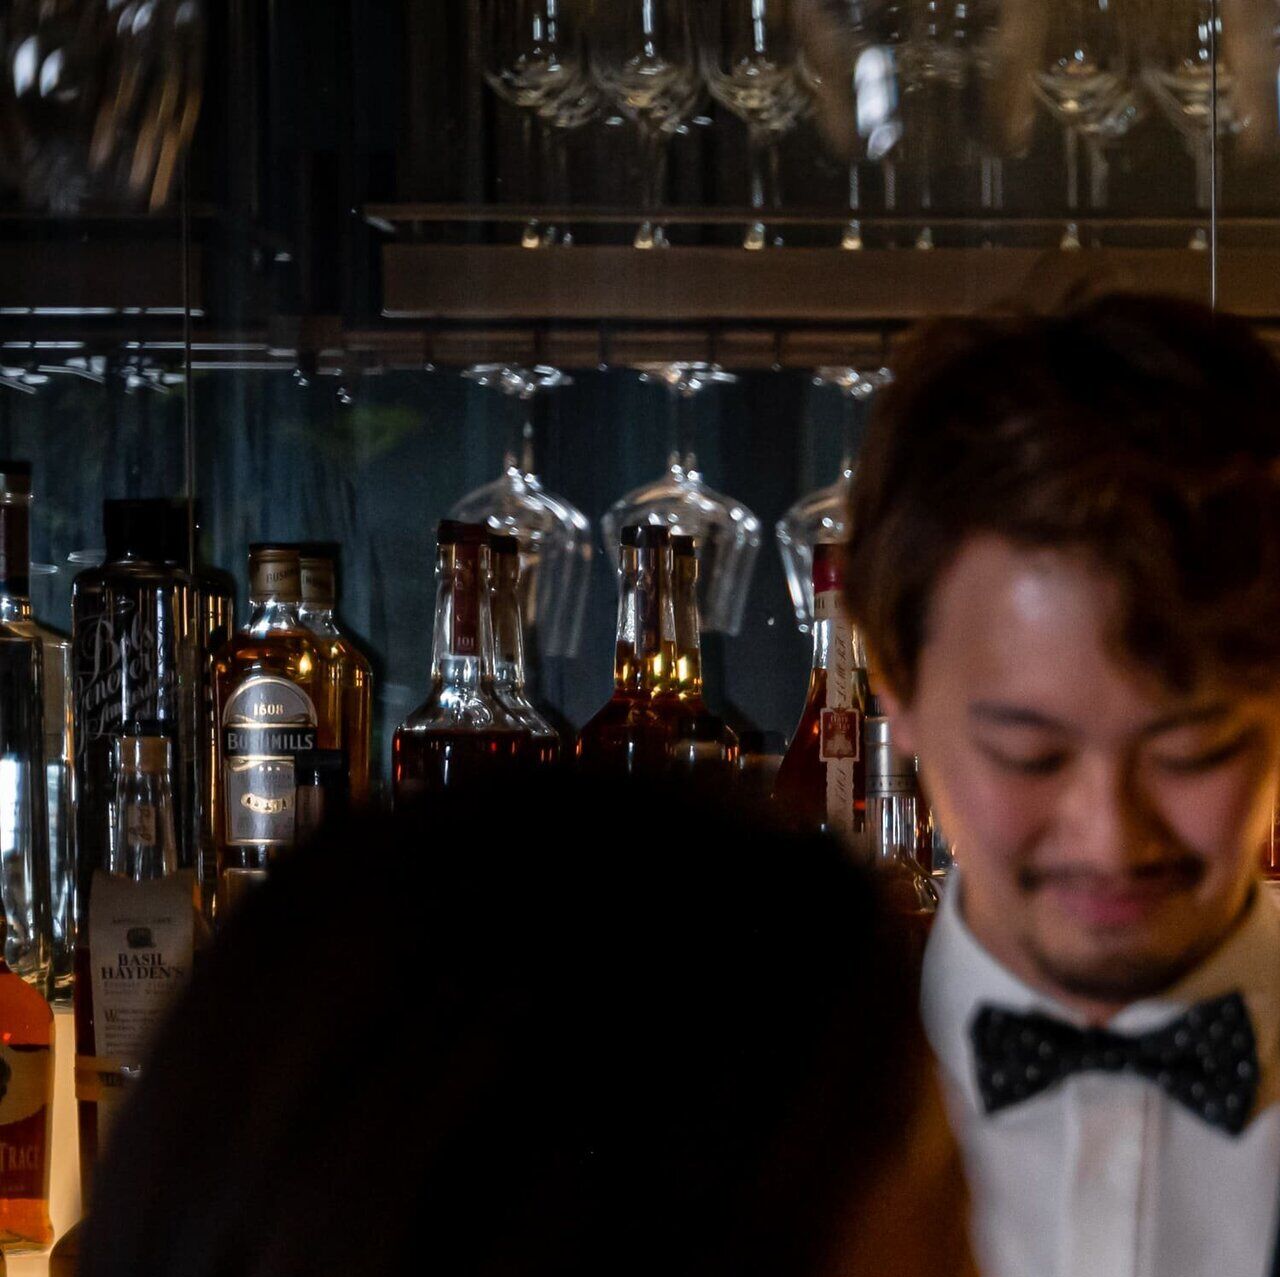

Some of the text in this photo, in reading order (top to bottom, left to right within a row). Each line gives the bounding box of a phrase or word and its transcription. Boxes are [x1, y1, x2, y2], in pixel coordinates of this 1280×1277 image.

[253, 704, 283, 715] 1608
[118, 953, 167, 966] BASIL
[101, 966, 184, 979] HAYDEN'S
